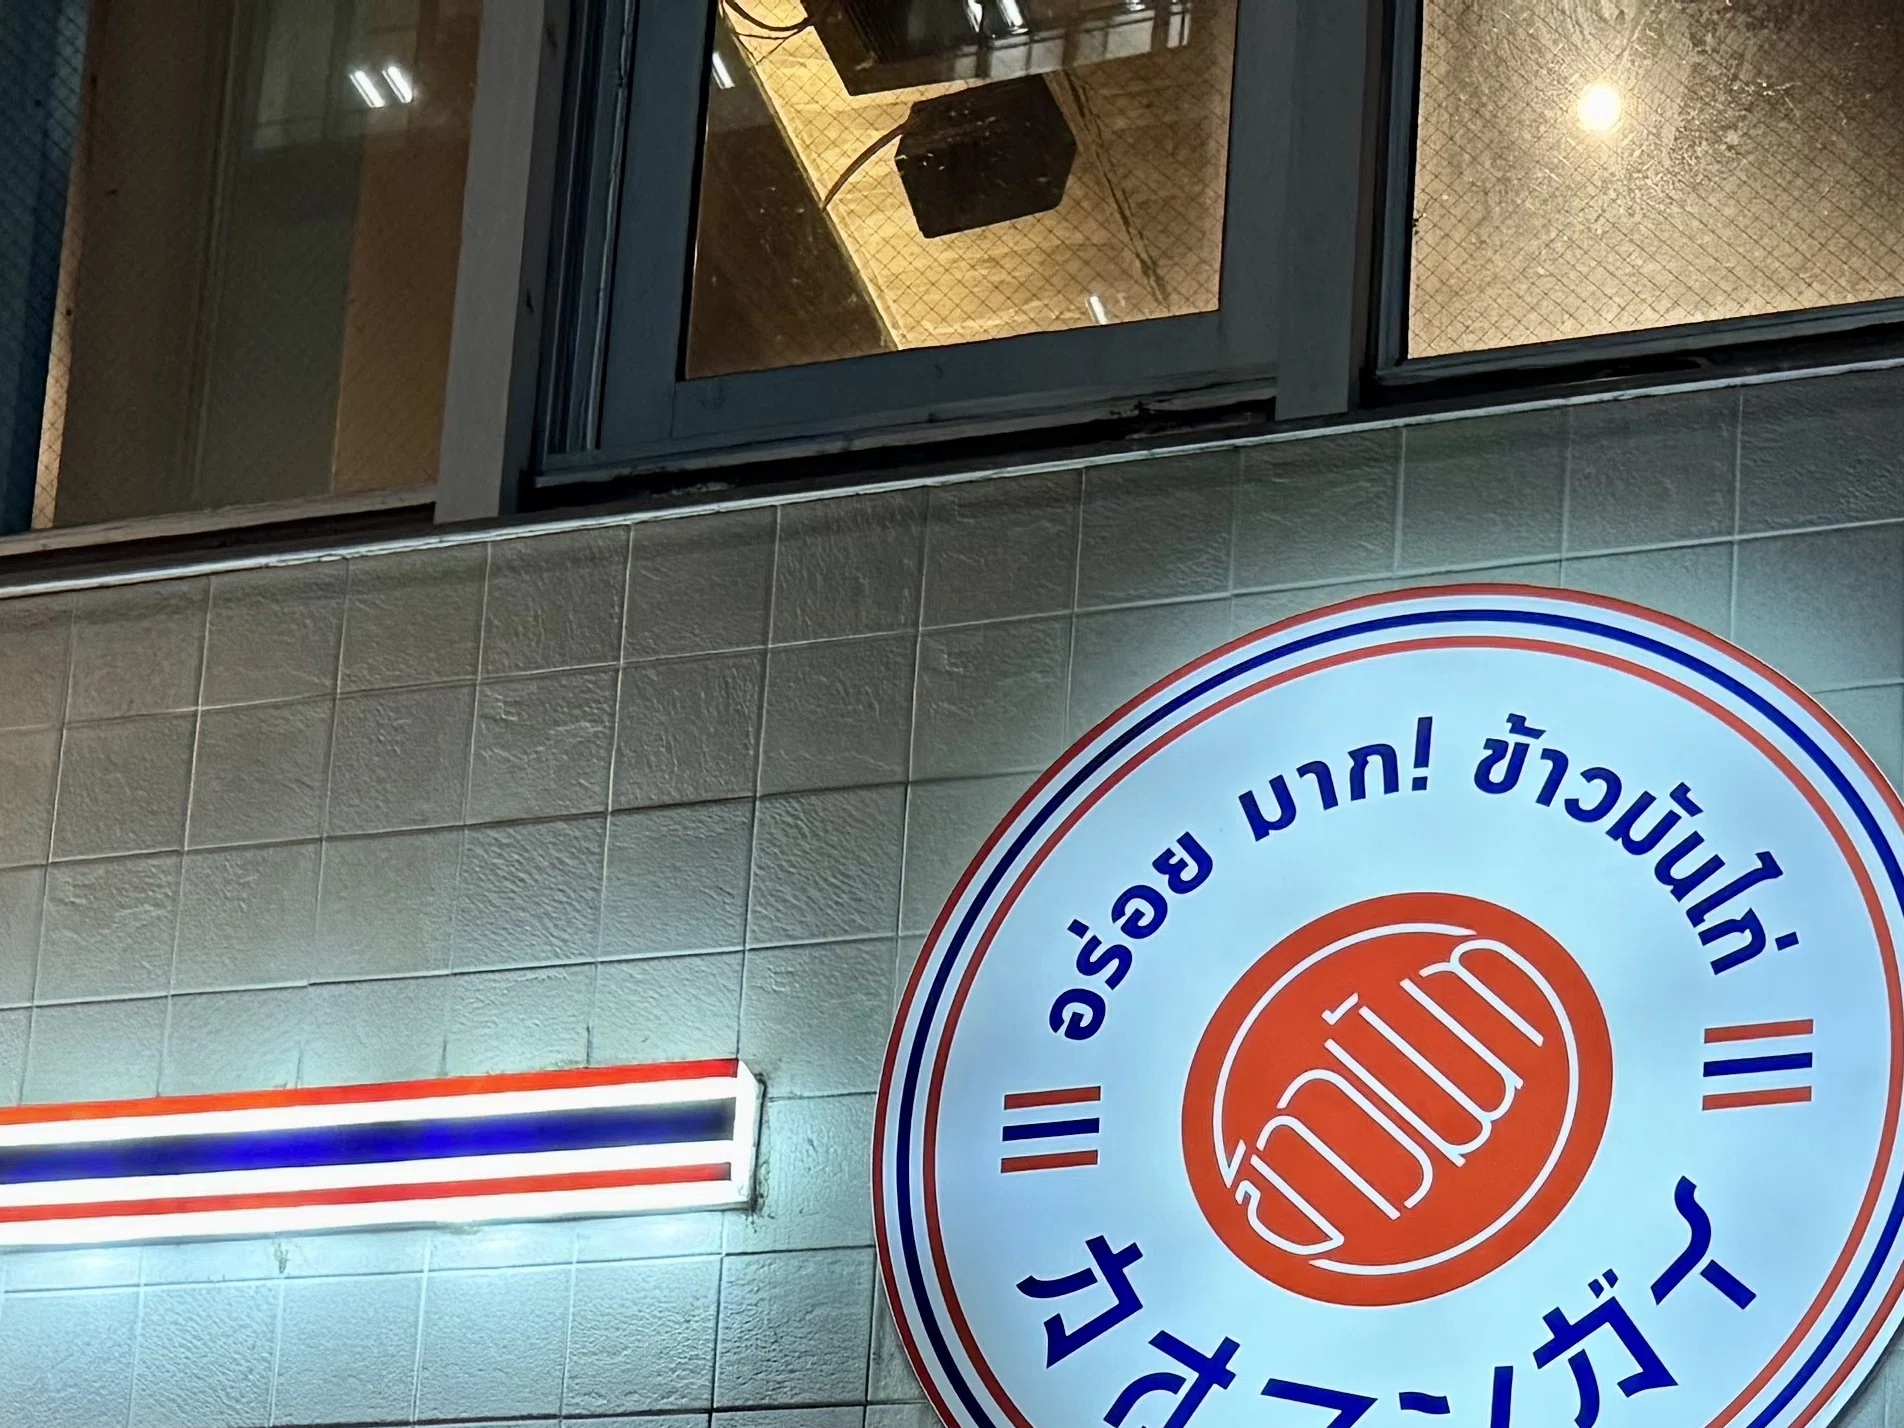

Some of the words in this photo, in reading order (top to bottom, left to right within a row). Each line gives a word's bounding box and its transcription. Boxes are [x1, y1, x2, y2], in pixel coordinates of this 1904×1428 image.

[1049, 829, 1215, 1042] อร่อย
[1237, 713, 1434, 844] มาก!
[1472, 710, 1800, 977] ข้าวมันไก่
